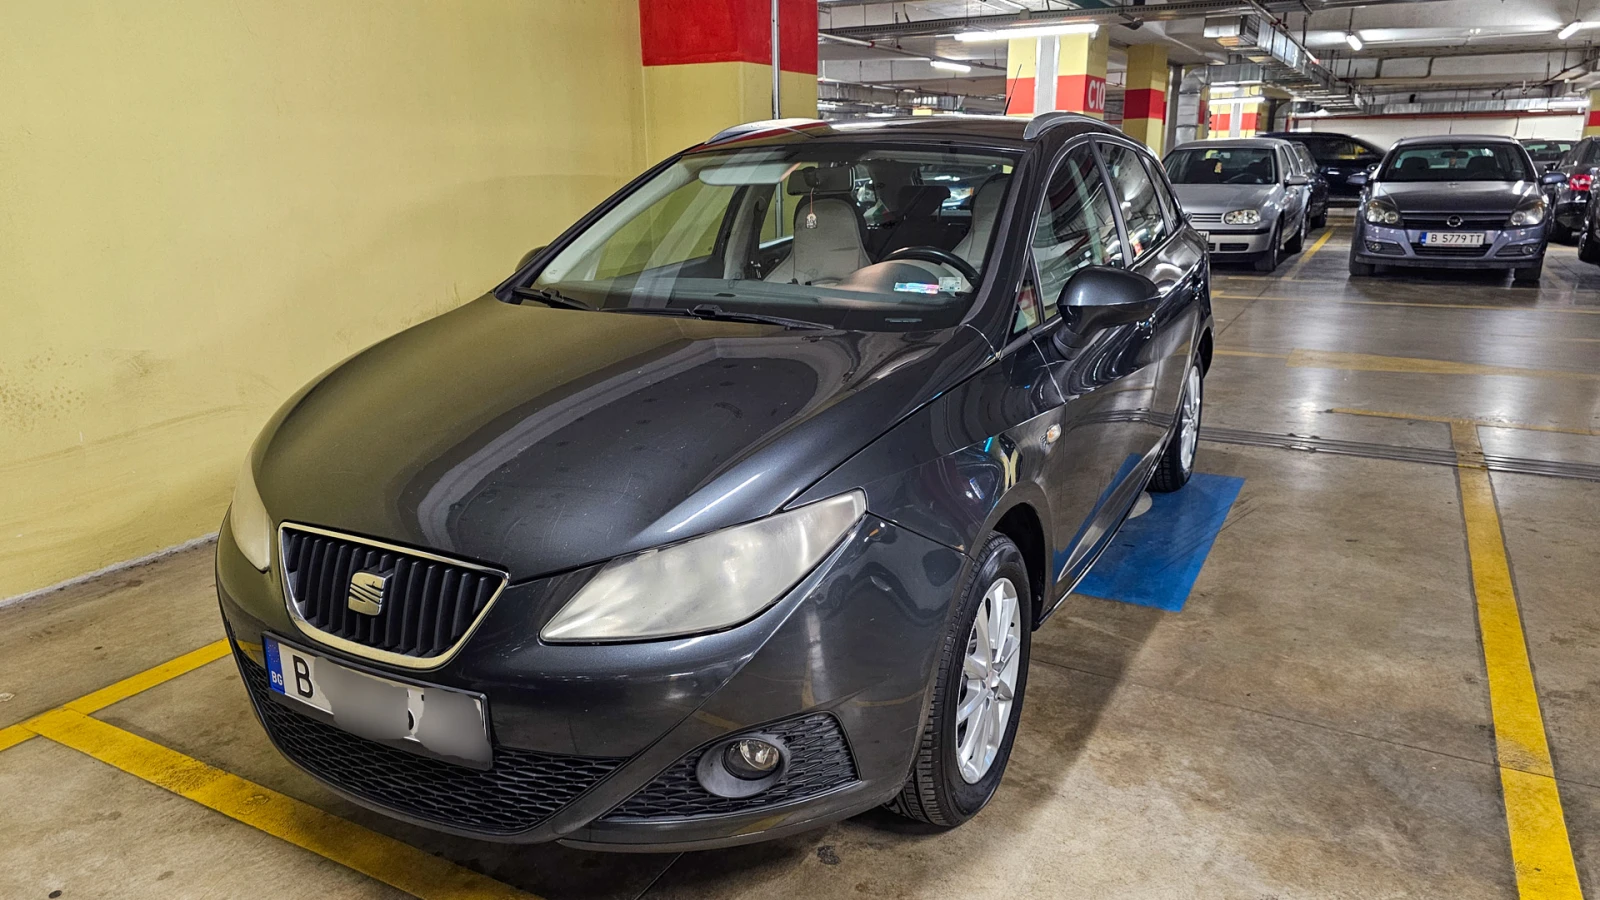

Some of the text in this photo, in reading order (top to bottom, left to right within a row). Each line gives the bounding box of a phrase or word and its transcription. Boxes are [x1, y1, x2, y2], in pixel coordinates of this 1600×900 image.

[1088, 80, 1105, 110] C10
[1431, 234, 1482, 243] B 5779 TT
[271, 670, 283, 686] BG
[292, 654, 314, 698] B
